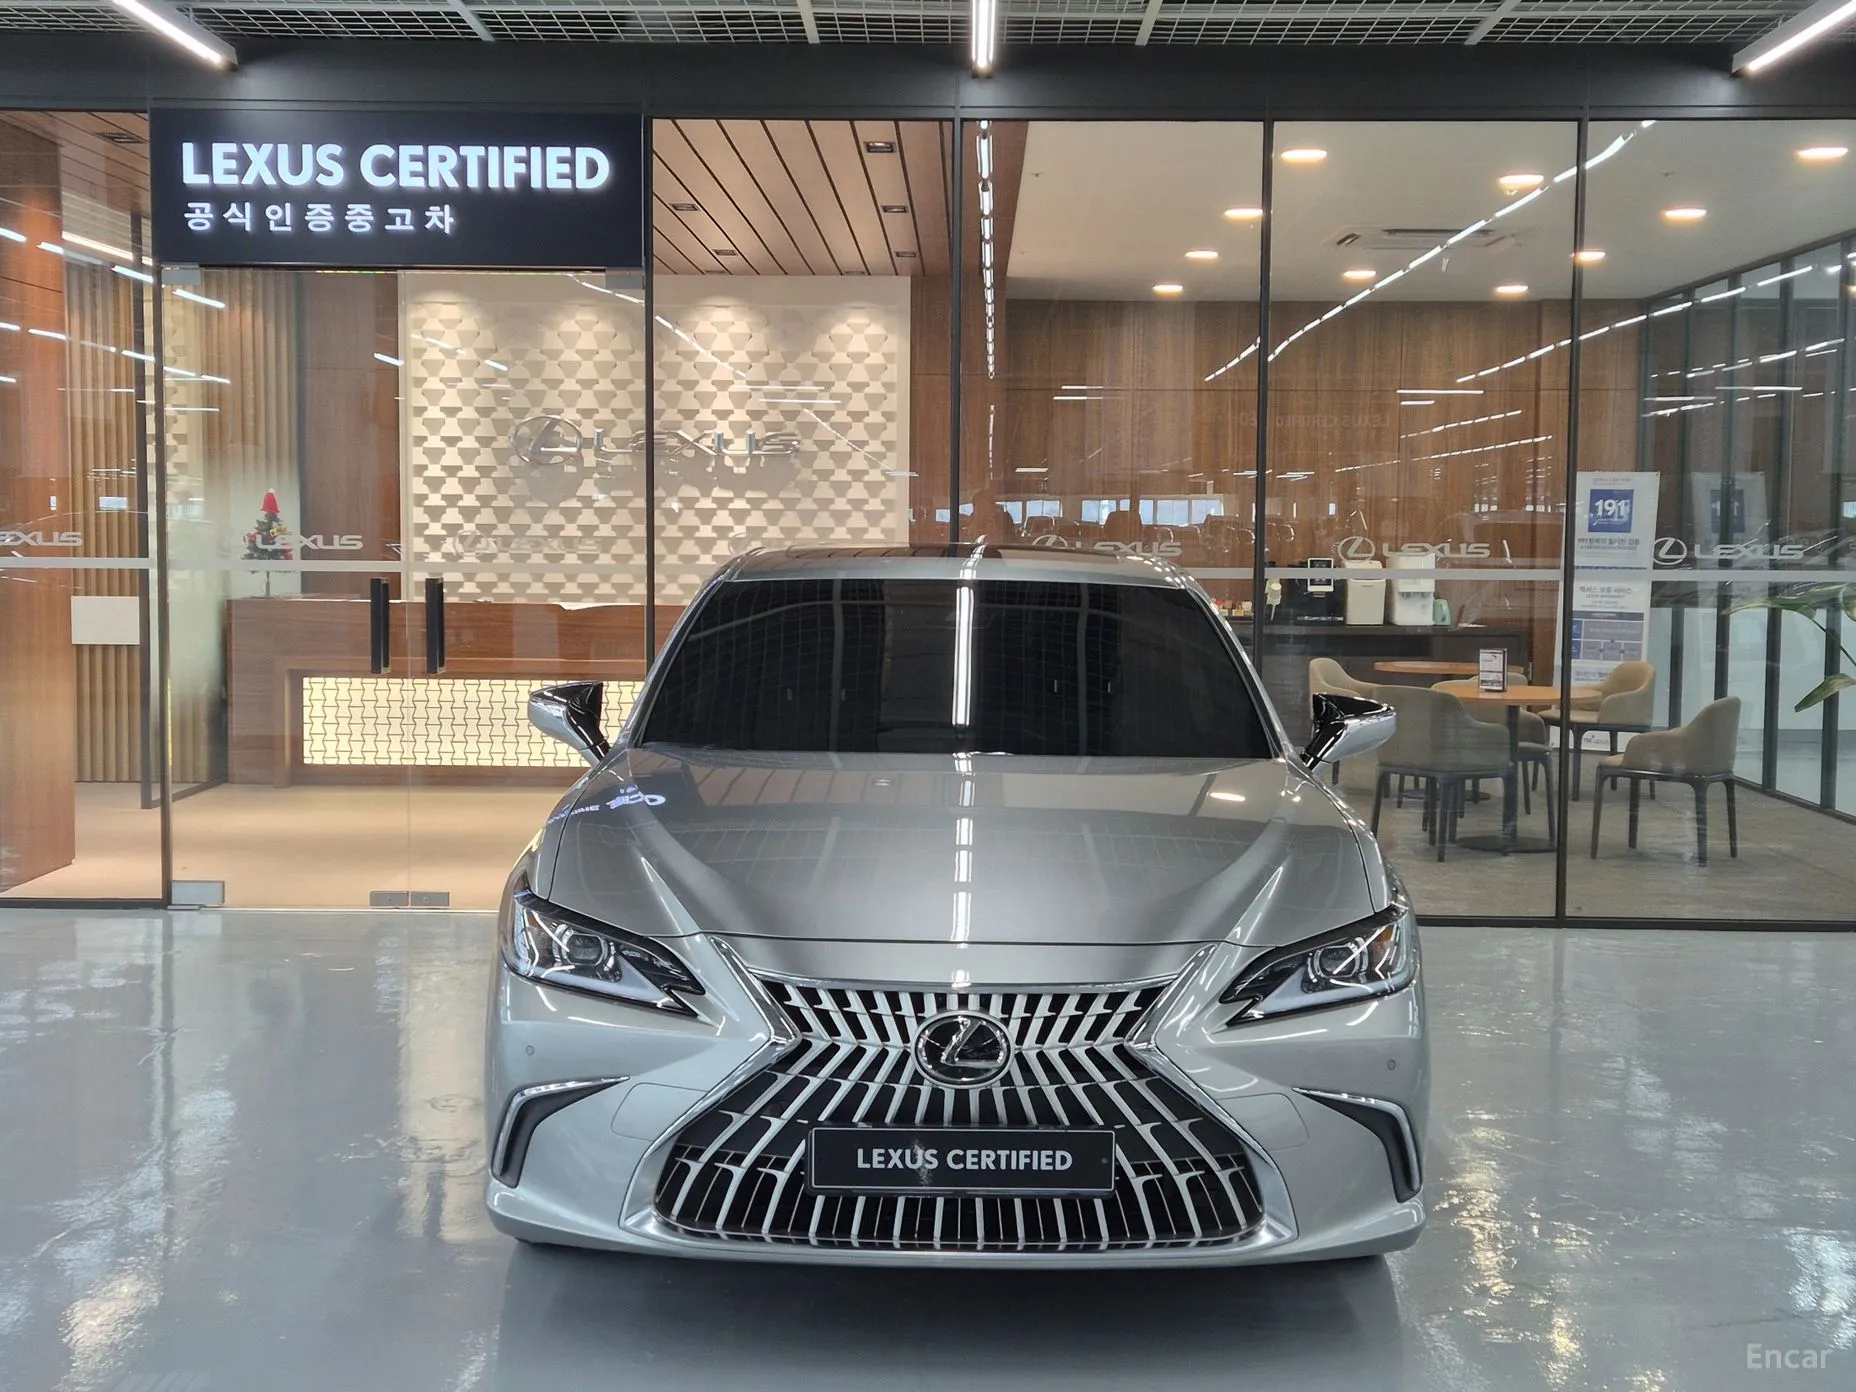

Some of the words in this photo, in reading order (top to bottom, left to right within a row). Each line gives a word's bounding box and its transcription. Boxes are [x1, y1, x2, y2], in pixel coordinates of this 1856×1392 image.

[181, 141, 345, 188] LEXUS
[359, 143, 611, 190] CERTIFIED
[183, 202, 455, 234] 공식인증중고차
[593, 418, 800, 456] LEXUS
[1594, 499, 1627, 518] 191
[0, 531, 83, 547] EXUS
[1382, 543, 1491, 558] LEXUS
[1694, 543, 1804, 560] LEXUS
[857, 1148, 938, 1169] LEXUS
[947, 1149, 1073, 1170] CERTIFIED
